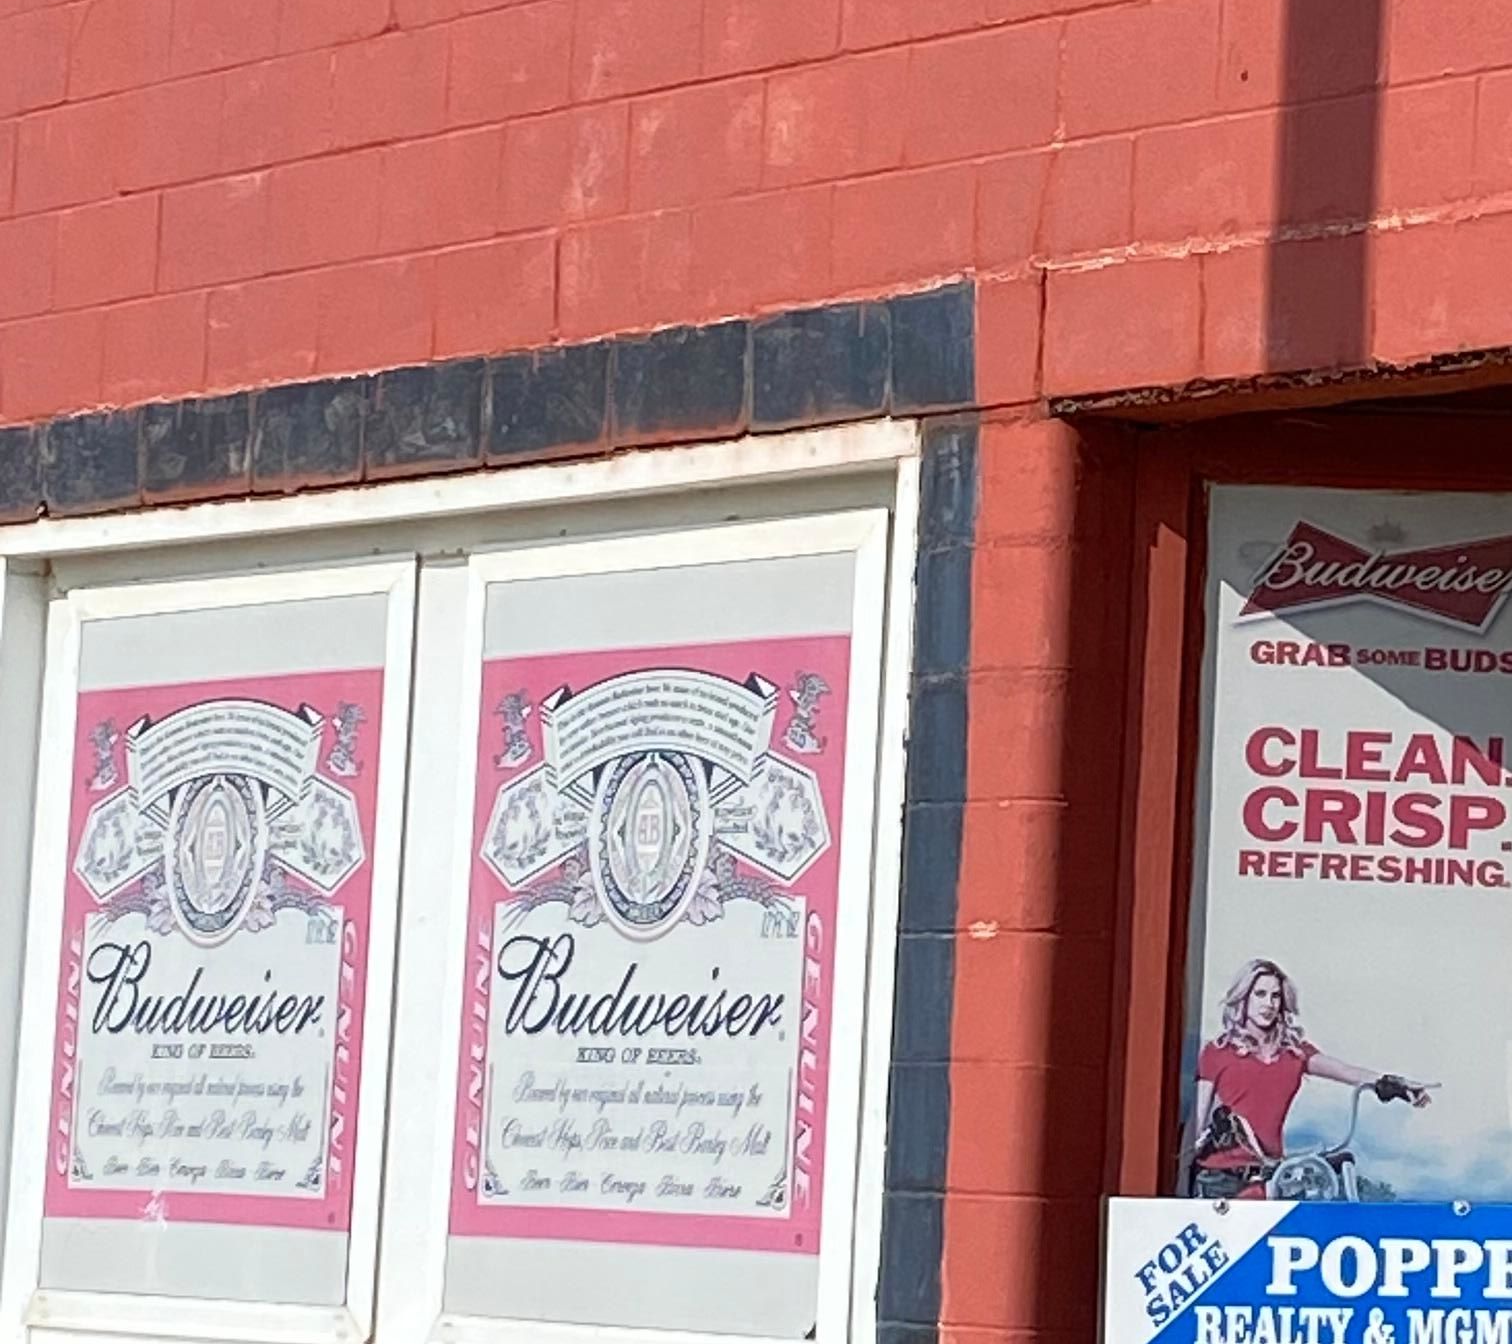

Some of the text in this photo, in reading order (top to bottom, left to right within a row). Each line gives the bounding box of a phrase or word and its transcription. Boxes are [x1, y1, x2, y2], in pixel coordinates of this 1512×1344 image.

[1250, 640, 1351, 667] GRAB
[1357, 647, 1421, 666] SOME
[1242, 785, 1512, 852] CRISP.
[1238, 850, 1511, 888] REFRESHING.
[87, 942, 324, 1035] Budweiser
[497, 933, 785, 1037] Budweiser
[621, 1047, 641, 1063] OF
[1134, 1223, 1208, 1296] FOR
[1146, 1240, 1230, 1327] SALE
